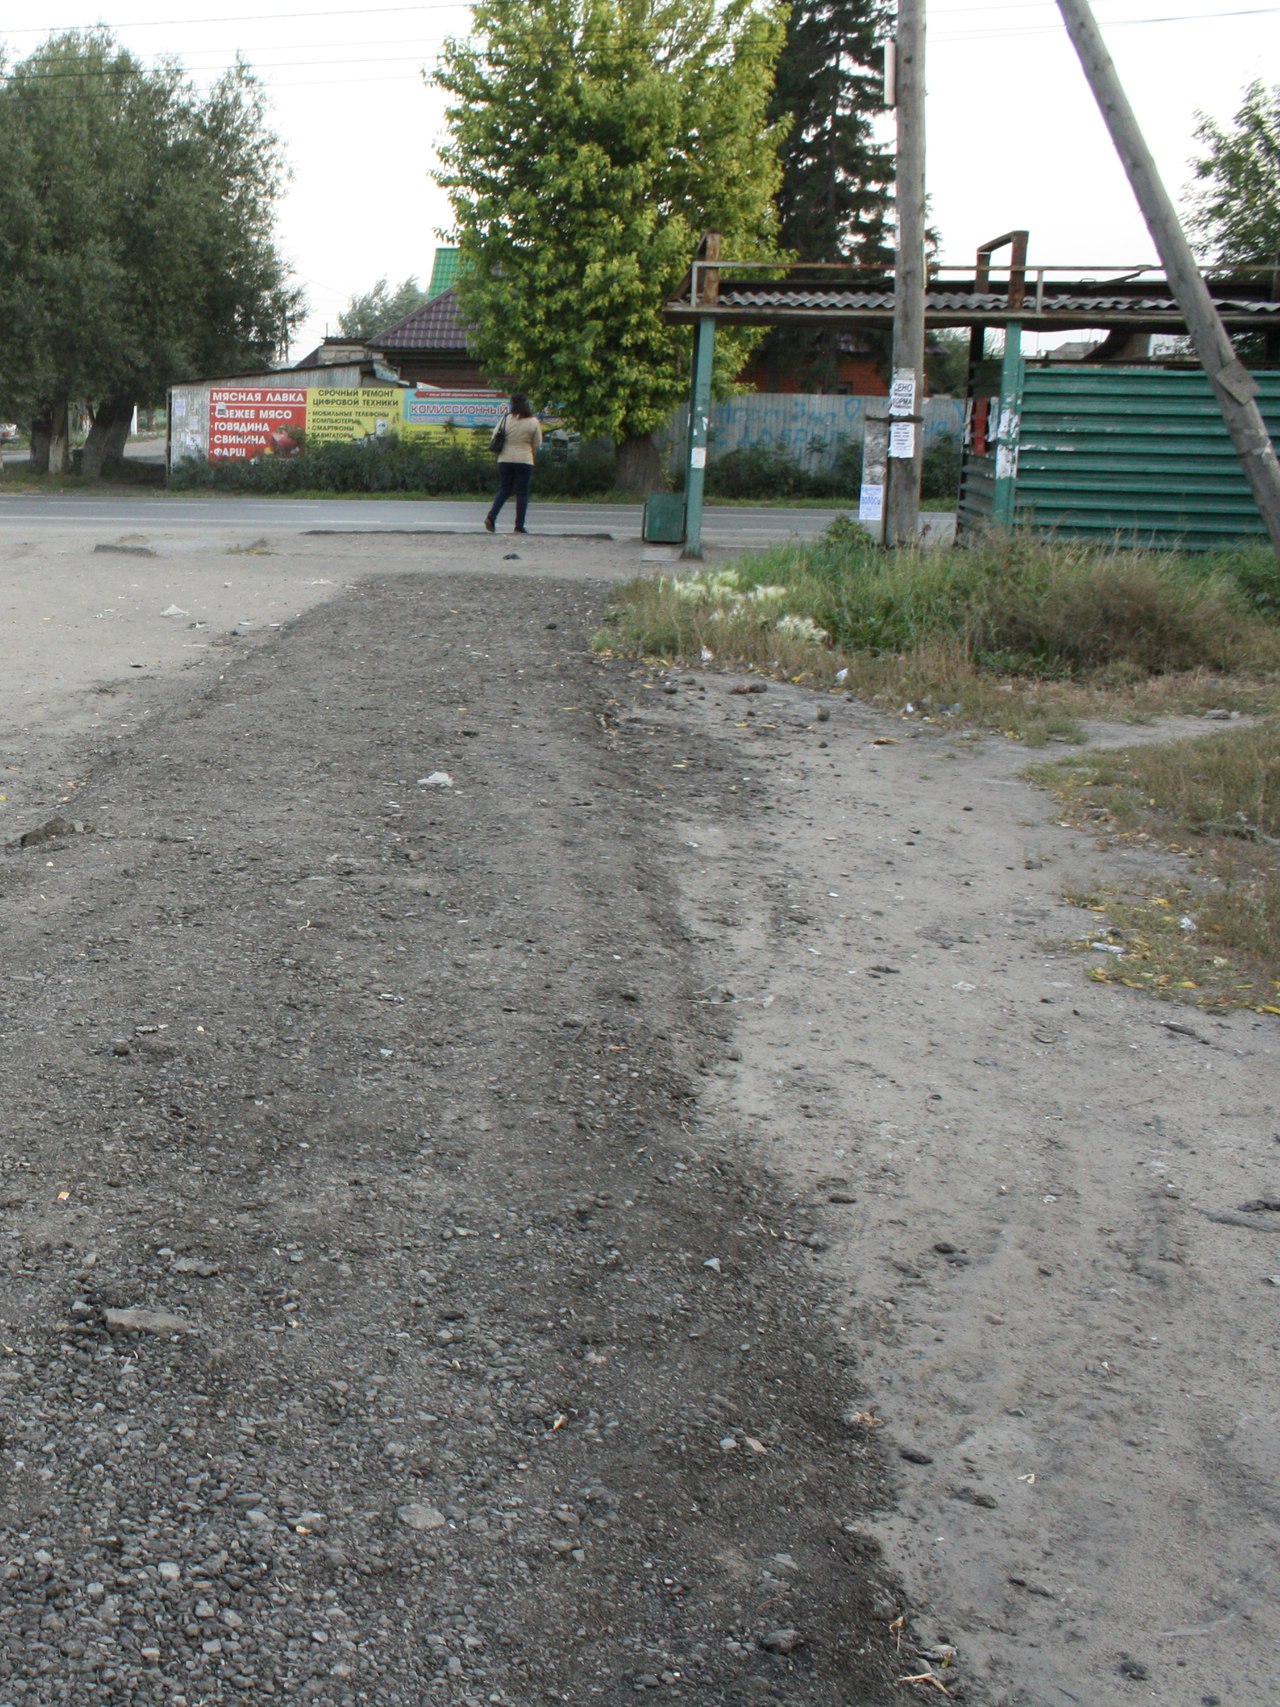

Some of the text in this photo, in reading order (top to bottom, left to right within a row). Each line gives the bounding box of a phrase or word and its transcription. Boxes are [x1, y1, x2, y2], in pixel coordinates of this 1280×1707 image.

[318, 388, 359, 396] СРОЧНЫЙ
[212, 392, 305, 402] МЯСНАЯ ЛАВКА
[313, 398, 359, 406] ЦИФРОВОЙ
[411, 402, 510, 415] КОМИССИОННЫЙ
[259, 410, 292, 419] МЯСО
[214, 422, 270, 432] ГОВЯДИНА
[214, 435, 266, 444] СВИНИНА
[214, 447, 245, 457] ФАРШ
